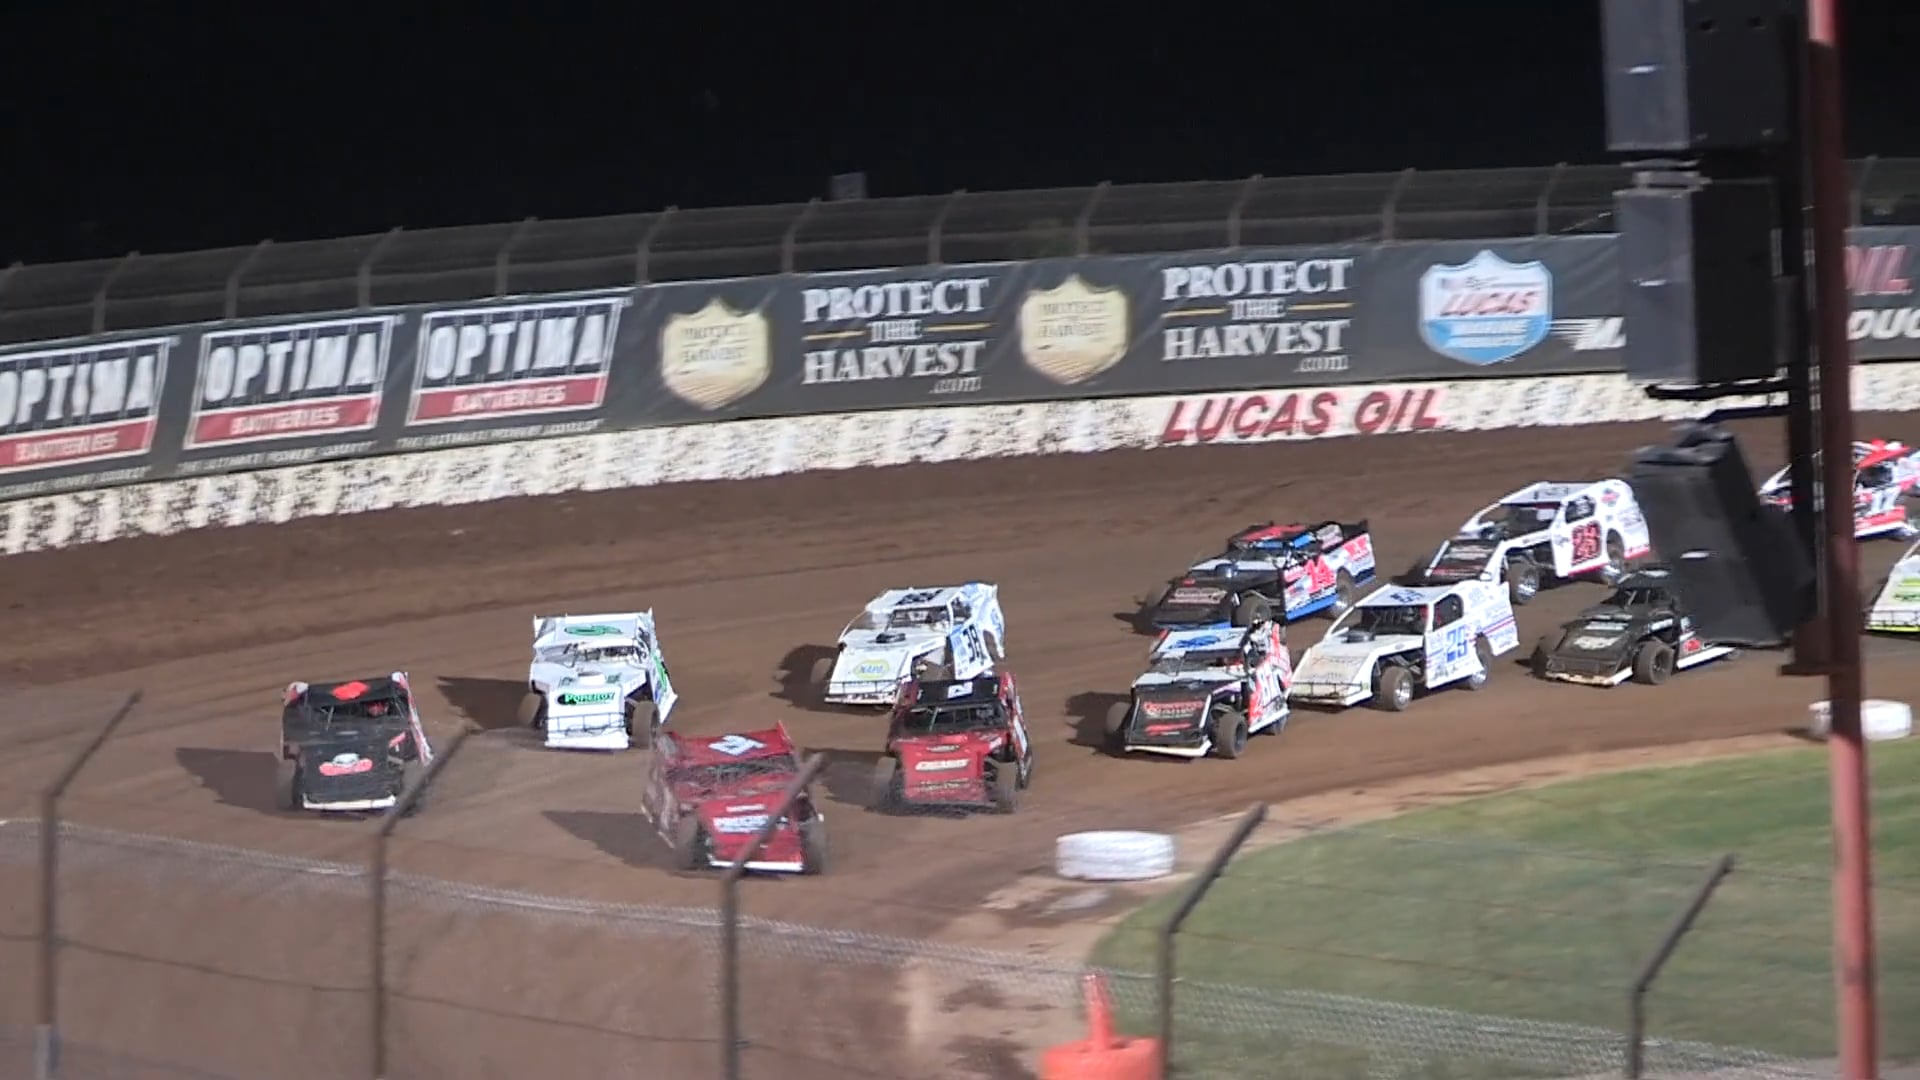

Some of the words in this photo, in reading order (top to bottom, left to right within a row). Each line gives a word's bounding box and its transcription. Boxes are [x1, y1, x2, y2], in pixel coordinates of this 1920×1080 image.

[801, 278, 990, 322] PROTECT
[1161, 257, 1355, 300] PROTECT
[1228, 297, 1288, 320] THE
[1440, 290, 1539, 316] LUCAS
[427, 313, 606, 380] OPTIMA
[865, 319, 924, 342] THE
[1161, 319, 1351, 361] HARVEST
[204, 332, 378, 402] OPTIMA
[801, 340, 987, 384] HARVEST
[0, 355, 155, 427] OPTIMA
[1162, 391, 1338, 443] LUCAS
[1354, 389, 1438, 433] OIL
[1446, 623, 1469, 664] 25
